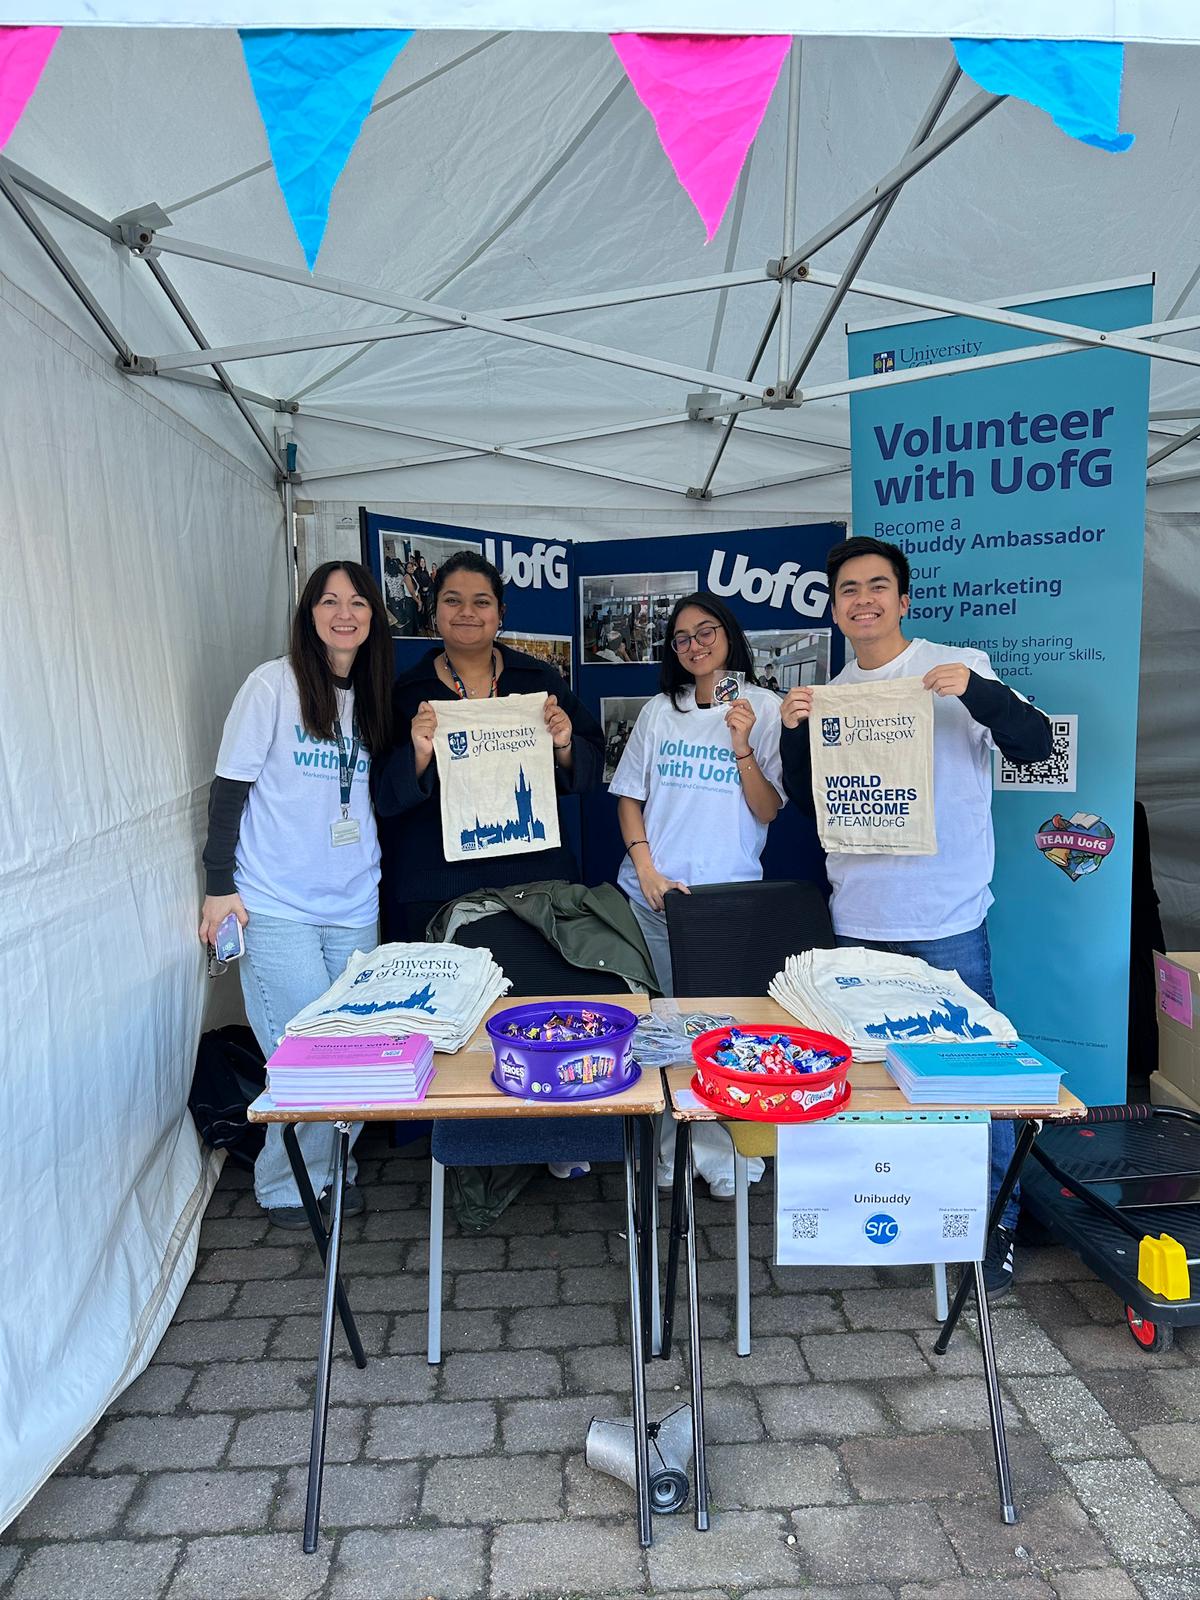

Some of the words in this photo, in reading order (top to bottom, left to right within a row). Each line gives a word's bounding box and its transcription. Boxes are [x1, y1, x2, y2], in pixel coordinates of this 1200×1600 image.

[900, 339, 982, 363] University
[873, 406, 1114, 461] Volunteer
[874, 460, 974, 506] with
[991, 448, 1112, 494] UofG
[874, 518, 944, 538] Become
[950, 518, 961, 531] a
[900, 534, 966, 555] ibuddy
[971, 526, 1106, 550] Ambassador
[484, 537, 569, 590] UofG
[910, 566, 941, 580] our
[707, 549, 830, 618] UofG
[953, 577, 1062, 597] Marketing
[907, 603, 954, 622] isory
[960, 598, 1016, 617] Panel
[1002, 636, 1018, 650] by
[1022, 635, 1073, 650] sharing
[1033, 652, 1065, 665] your
[1068, 648, 1106, 662] skills,
[844, 713, 916, 729] University
[471, 724, 536, 741] University
[845, 729, 858, 745] of
[857, 728, 916, 744] Glasgow
[472, 741, 484, 757] of
[484, 740, 537, 753] Glasgow
[659, 740, 738, 763] Voluntee
[294, 748, 340, 770] with
[657, 760, 693, 778] with
[825, 775, 881, 788] WORLD
[826, 788, 917, 801] CHANGERS
[826, 802, 909, 815] WELCOME
[1041, 834, 1074, 845] TEAM
[1078, 837, 1107, 850] UofG
[381, 956, 462, 974] University
[392, 968, 460, 980] Glasgow
[874, 1162, 891, 1173] 65
[854, 1193, 911, 1206] Unibuddy
